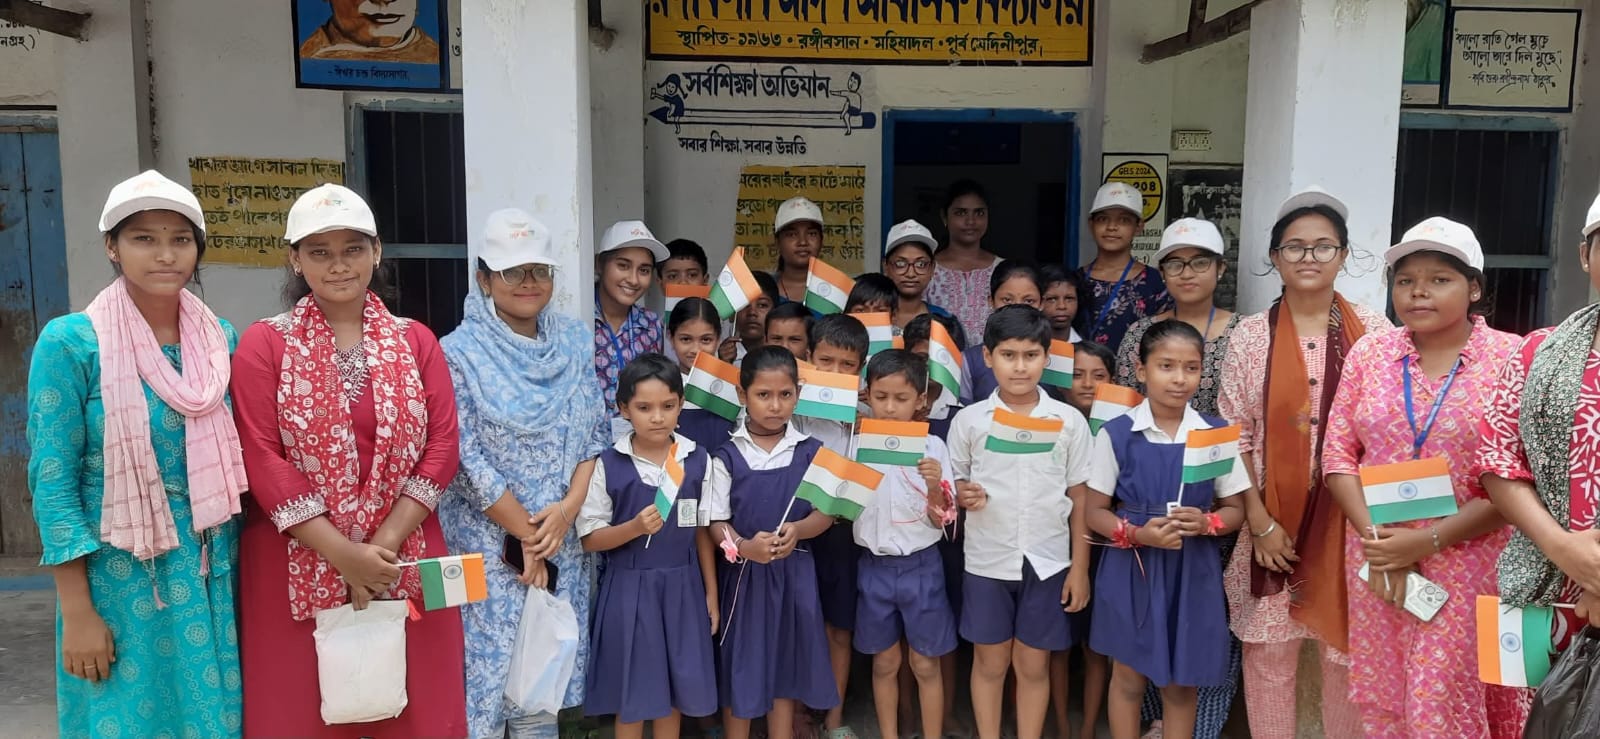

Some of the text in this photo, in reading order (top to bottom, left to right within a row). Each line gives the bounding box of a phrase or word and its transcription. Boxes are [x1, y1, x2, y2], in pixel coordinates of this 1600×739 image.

[871, 31, 935, 53] মহিষাদল
[946, 33, 969, 55] পূর্ব
[683, 64, 831, 98] সর্বশিক্ষা অভিযান
[678, 137, 707, 152] সবার
[744, 138, 772, 155] সবার
[776, 135, 807, 155] উন্নতি
